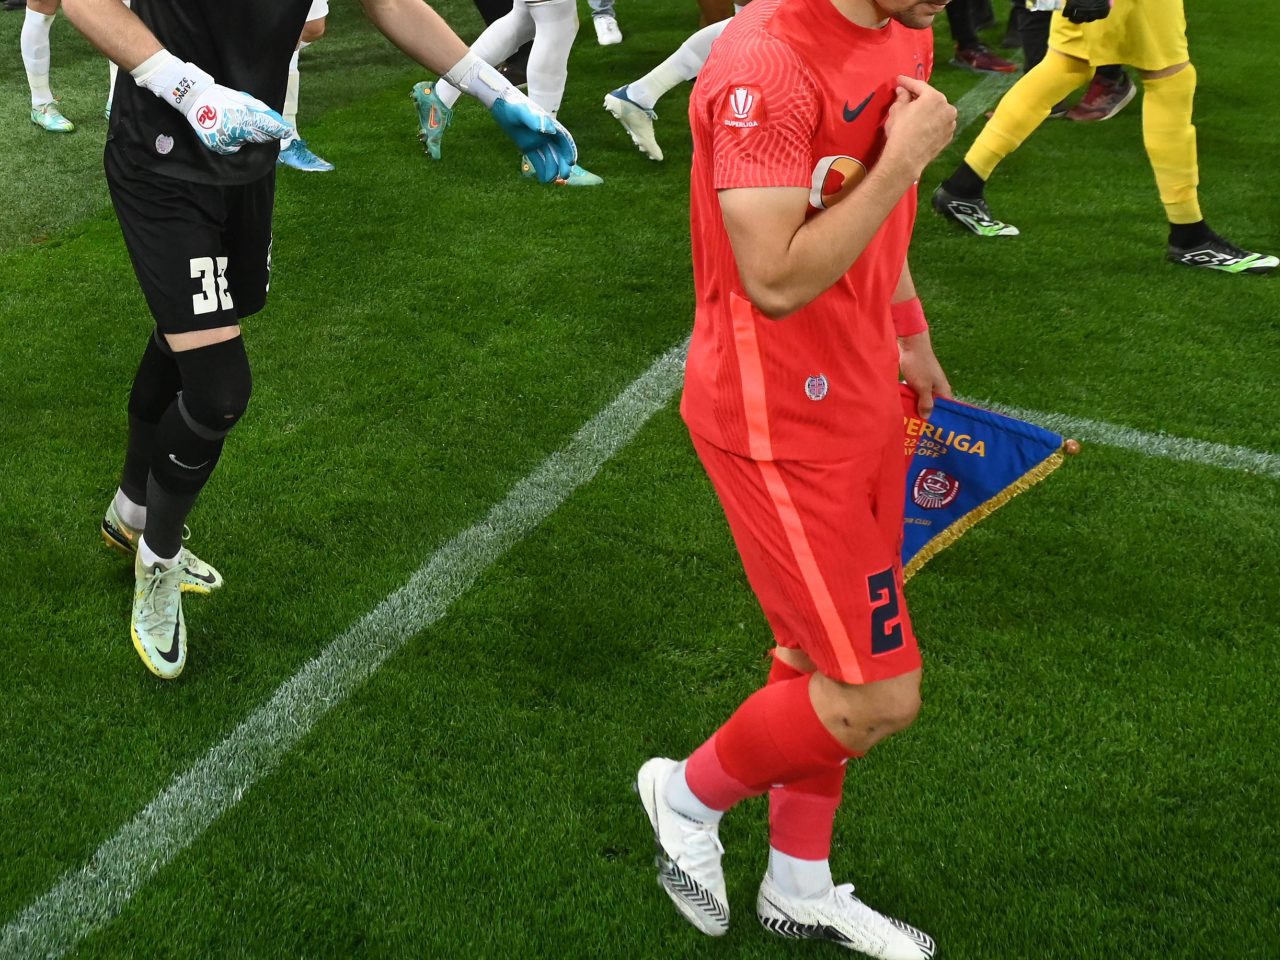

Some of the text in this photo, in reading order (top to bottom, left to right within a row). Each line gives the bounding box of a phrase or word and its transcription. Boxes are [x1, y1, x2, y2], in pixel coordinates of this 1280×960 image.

[723, 119, 760, 128] SUPERLIGA
[903, 416, 986, 458] ERLIGA
[903, 438, 948, 455] 22-2023
[867, 568, 904, 656] 2
